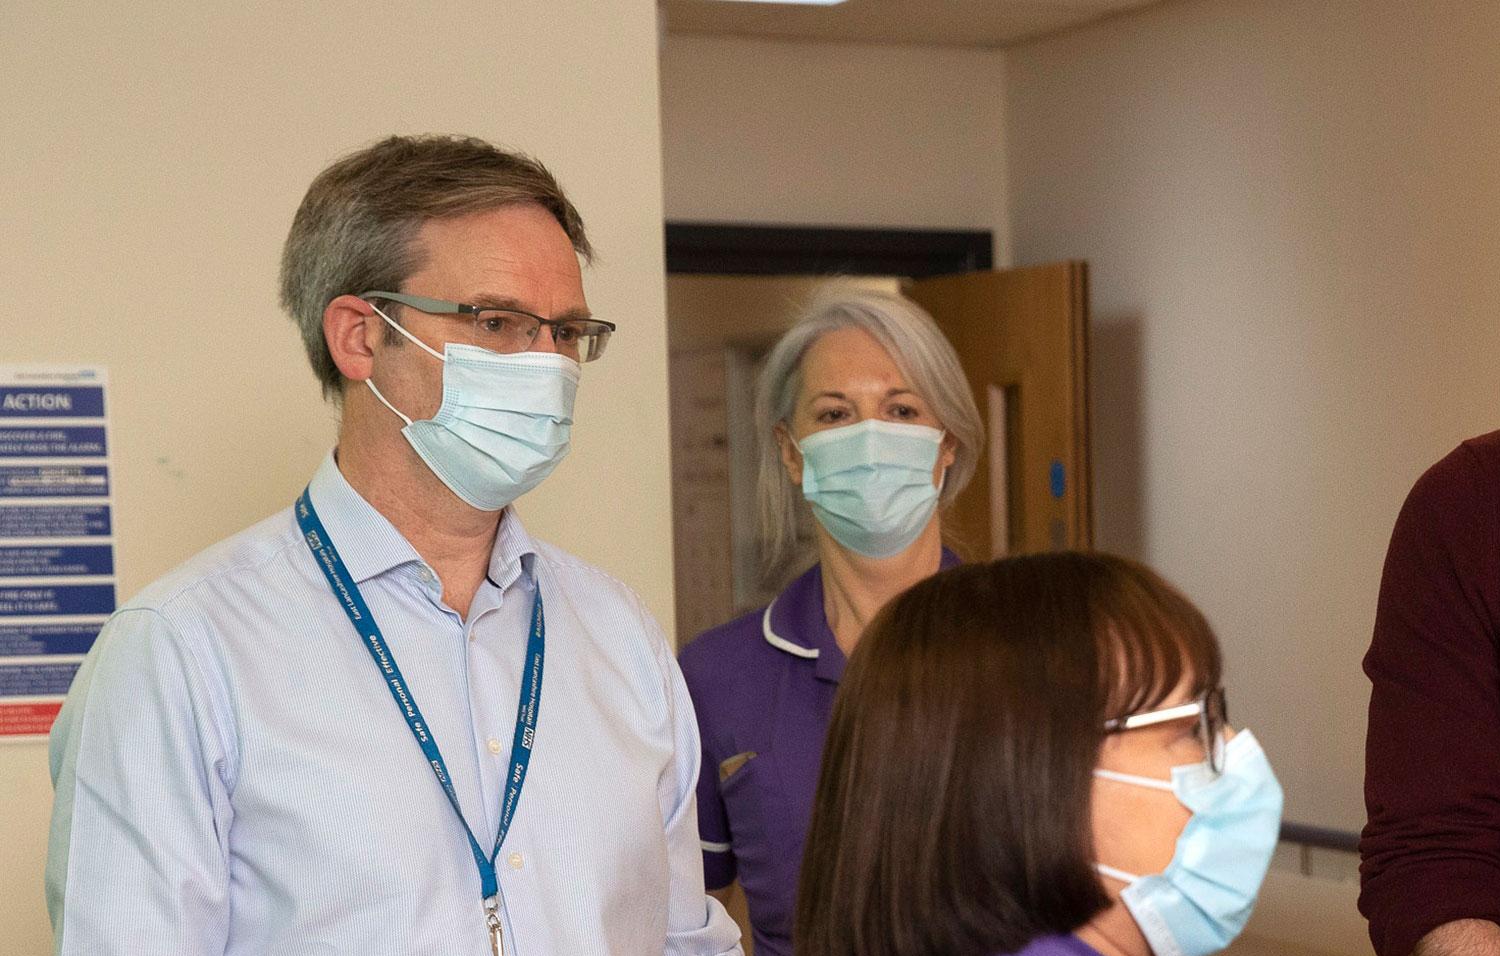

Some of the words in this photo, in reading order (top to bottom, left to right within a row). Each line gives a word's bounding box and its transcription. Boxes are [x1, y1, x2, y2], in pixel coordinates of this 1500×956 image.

[3, 393, 72, 409] ACTION
[368, 634, 395, 675] Effective
[390, 678, 416, 717] Personal
[414, 722, 428, 743] Safe
[521, 726, 534, 749] NHS
[511, 762, 523, 783] Safe
[502, 787, 517, 825] Personal
